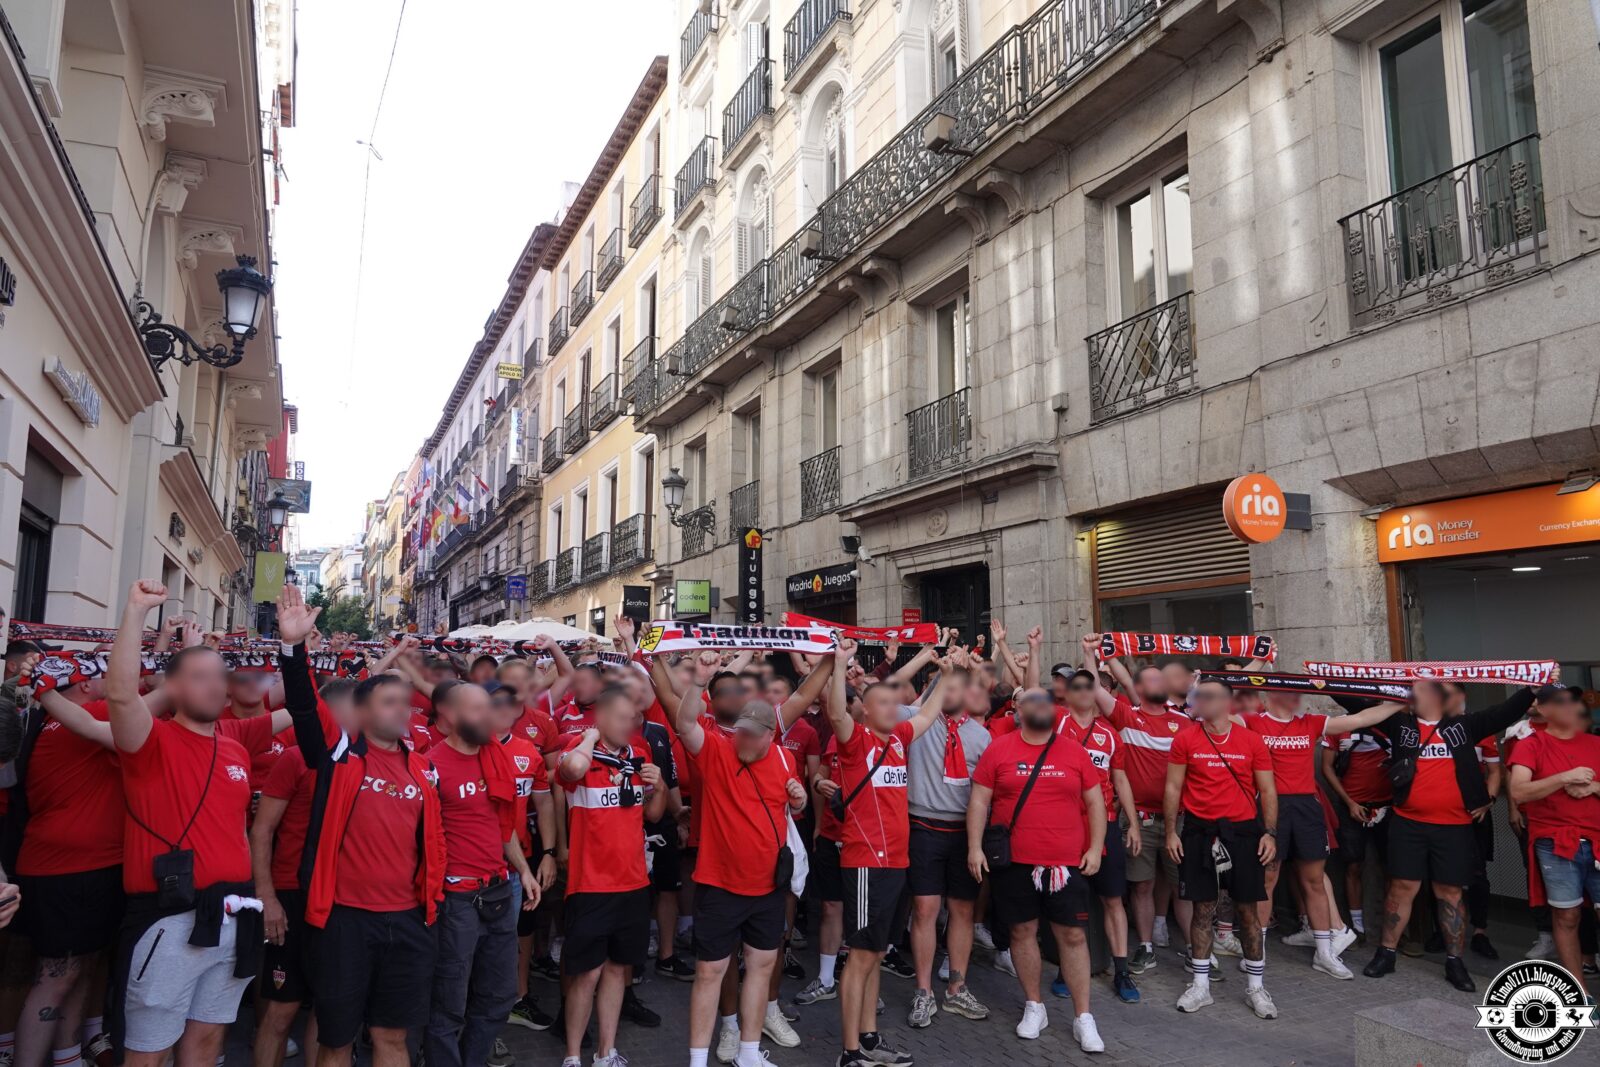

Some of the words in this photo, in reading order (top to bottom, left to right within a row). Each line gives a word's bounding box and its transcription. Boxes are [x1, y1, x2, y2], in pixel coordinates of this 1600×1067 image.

[1241, 483, 1280, 516] ria
[1242, 519, 1260, 527] Money
[1260, 519, 1280, 527] Transfer
[1437, 519, 1474, 531] Money
[1539, 522, 1571, 533] Currency
[1388, 514, 1435, 550] ria
[1438, 530, 1481, 544] Transfer
[748, 550, 757, 622] Juegos
[788, 578, 813, 593] Madrid
[823, 572, 851, 587] Juegos
[679, 592, 706, 601] codere
[673, 621, 811, 641] Tradition
[698, 638, 736, 647] wird
[740, 639, 796, 649] siegen!
[1308, 661, 1407, 679] SÜDBANDE
[1443, 661, 1556, 684] STUTTGART
